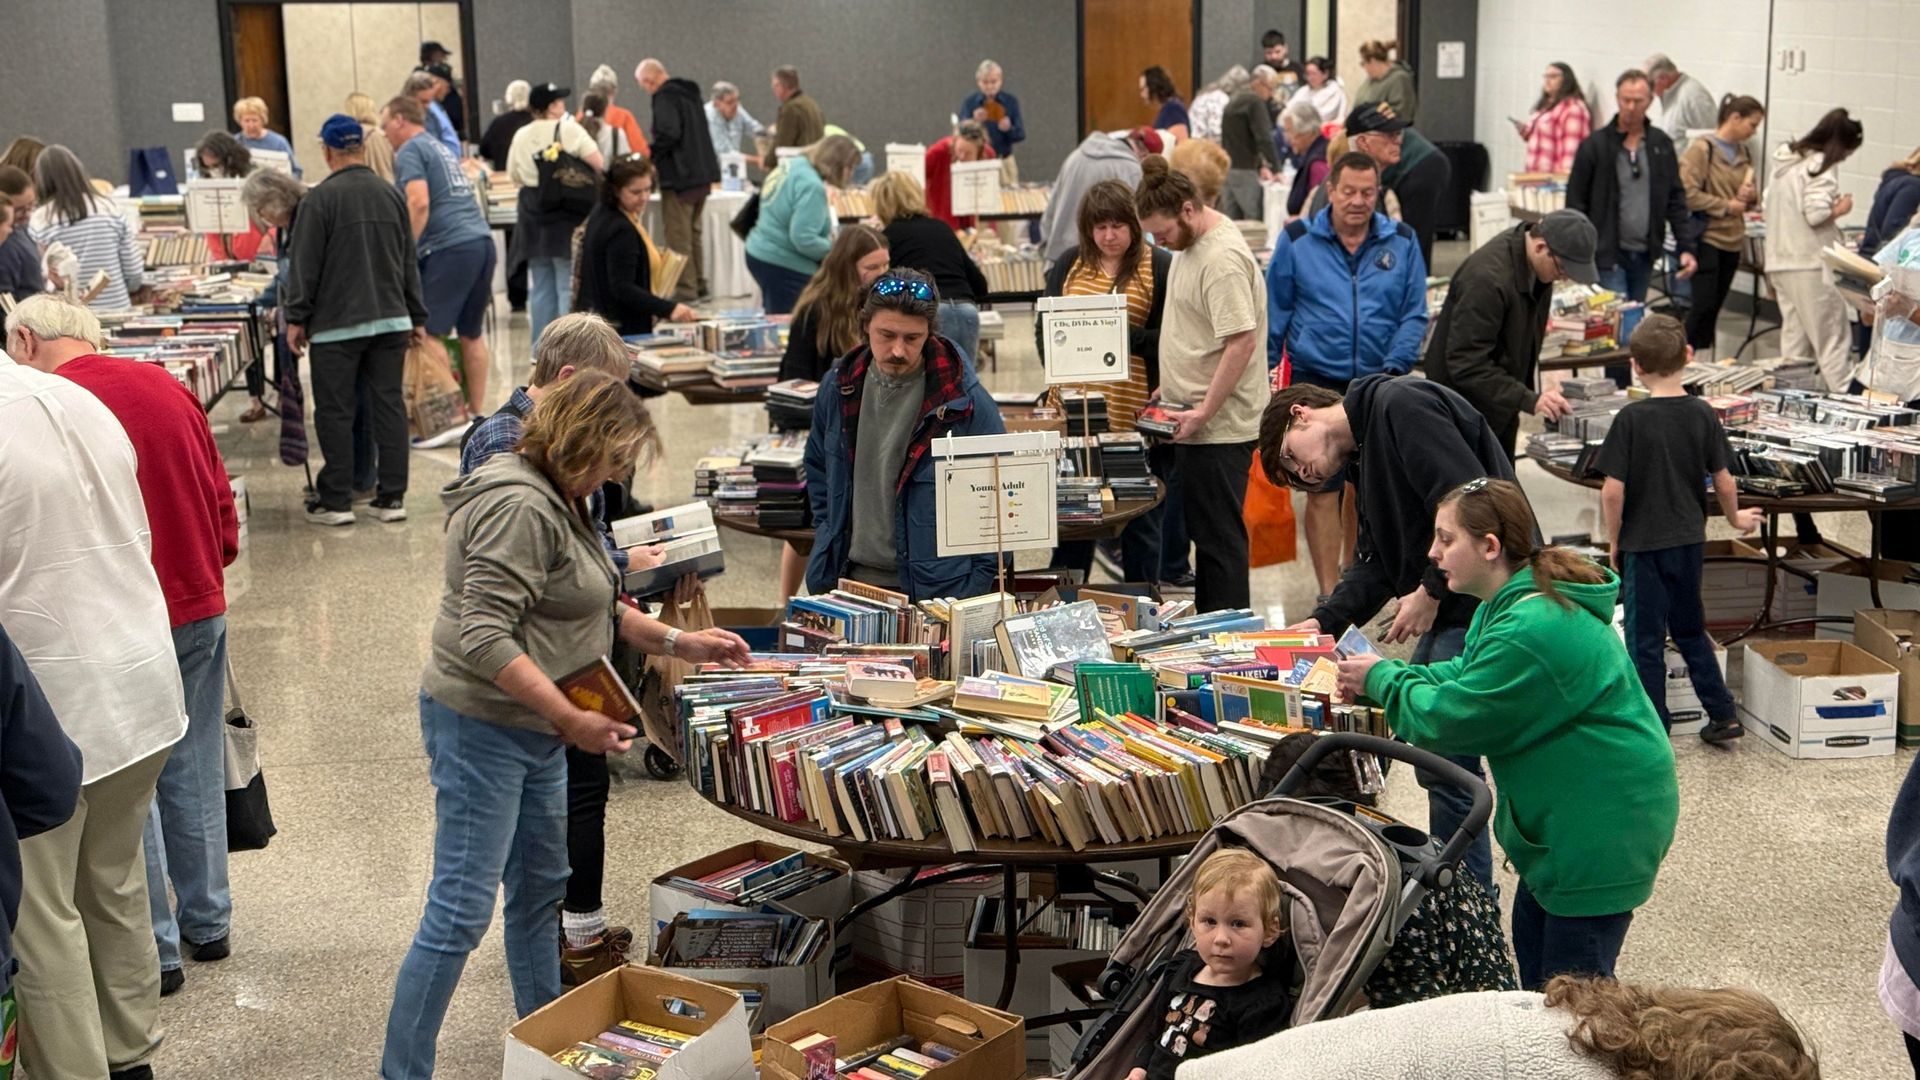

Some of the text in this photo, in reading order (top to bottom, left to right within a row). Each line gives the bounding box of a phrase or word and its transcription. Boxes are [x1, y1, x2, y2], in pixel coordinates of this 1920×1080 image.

[1100, 319, 1117, 327] Vinyl
[1002, 481, 1025, 490] Adult
[1241, 668, 1269, 679] LIKELY
